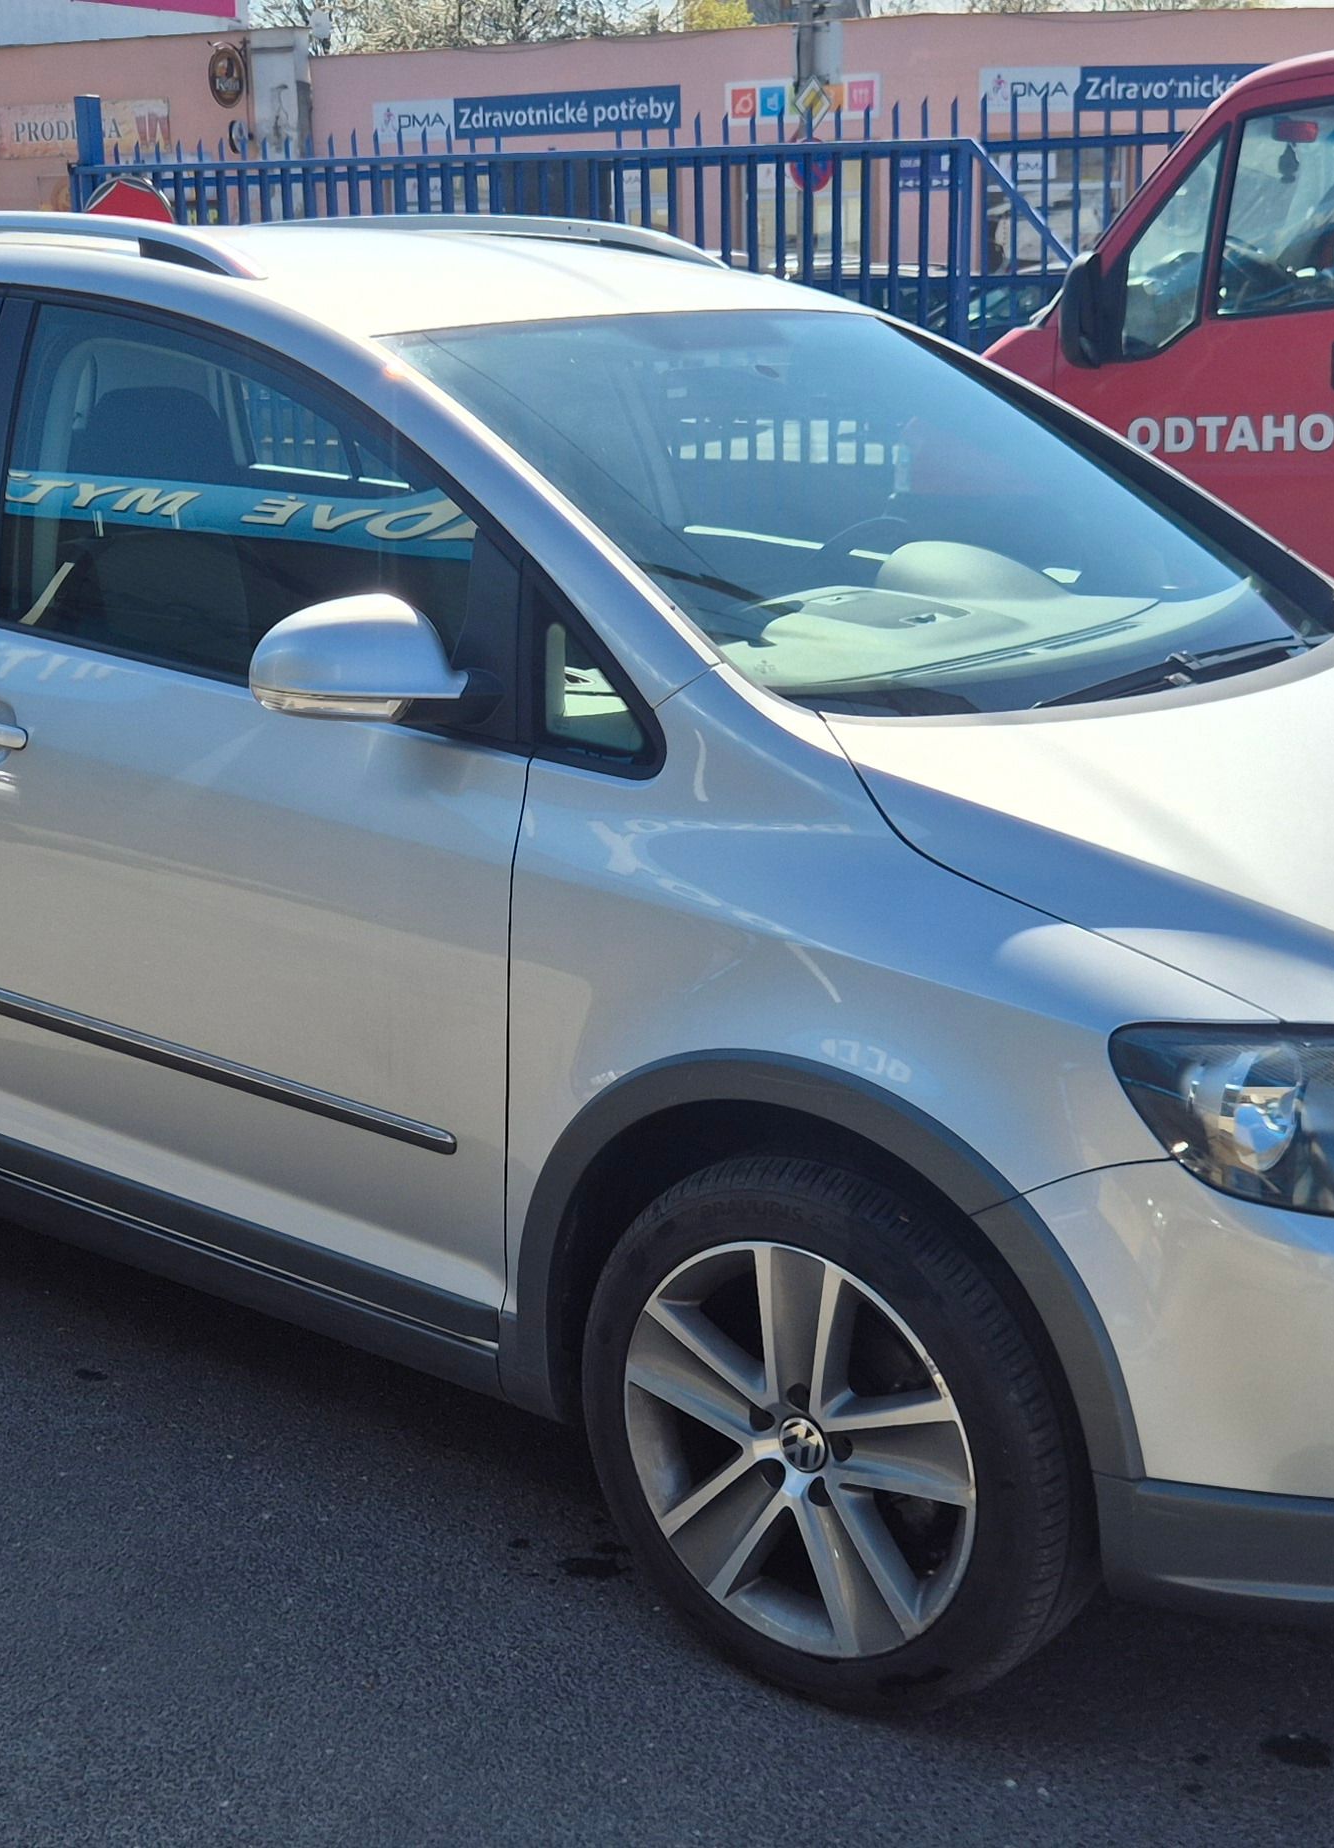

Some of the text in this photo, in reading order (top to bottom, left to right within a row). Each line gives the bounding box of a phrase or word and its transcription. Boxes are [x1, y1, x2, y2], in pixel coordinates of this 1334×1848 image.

[1085, 74, 1238, 100] Zdravonick
[458, 96, 676, 130] Zdravotnické potřeby
[14, 117, 123, 143] PRODA
